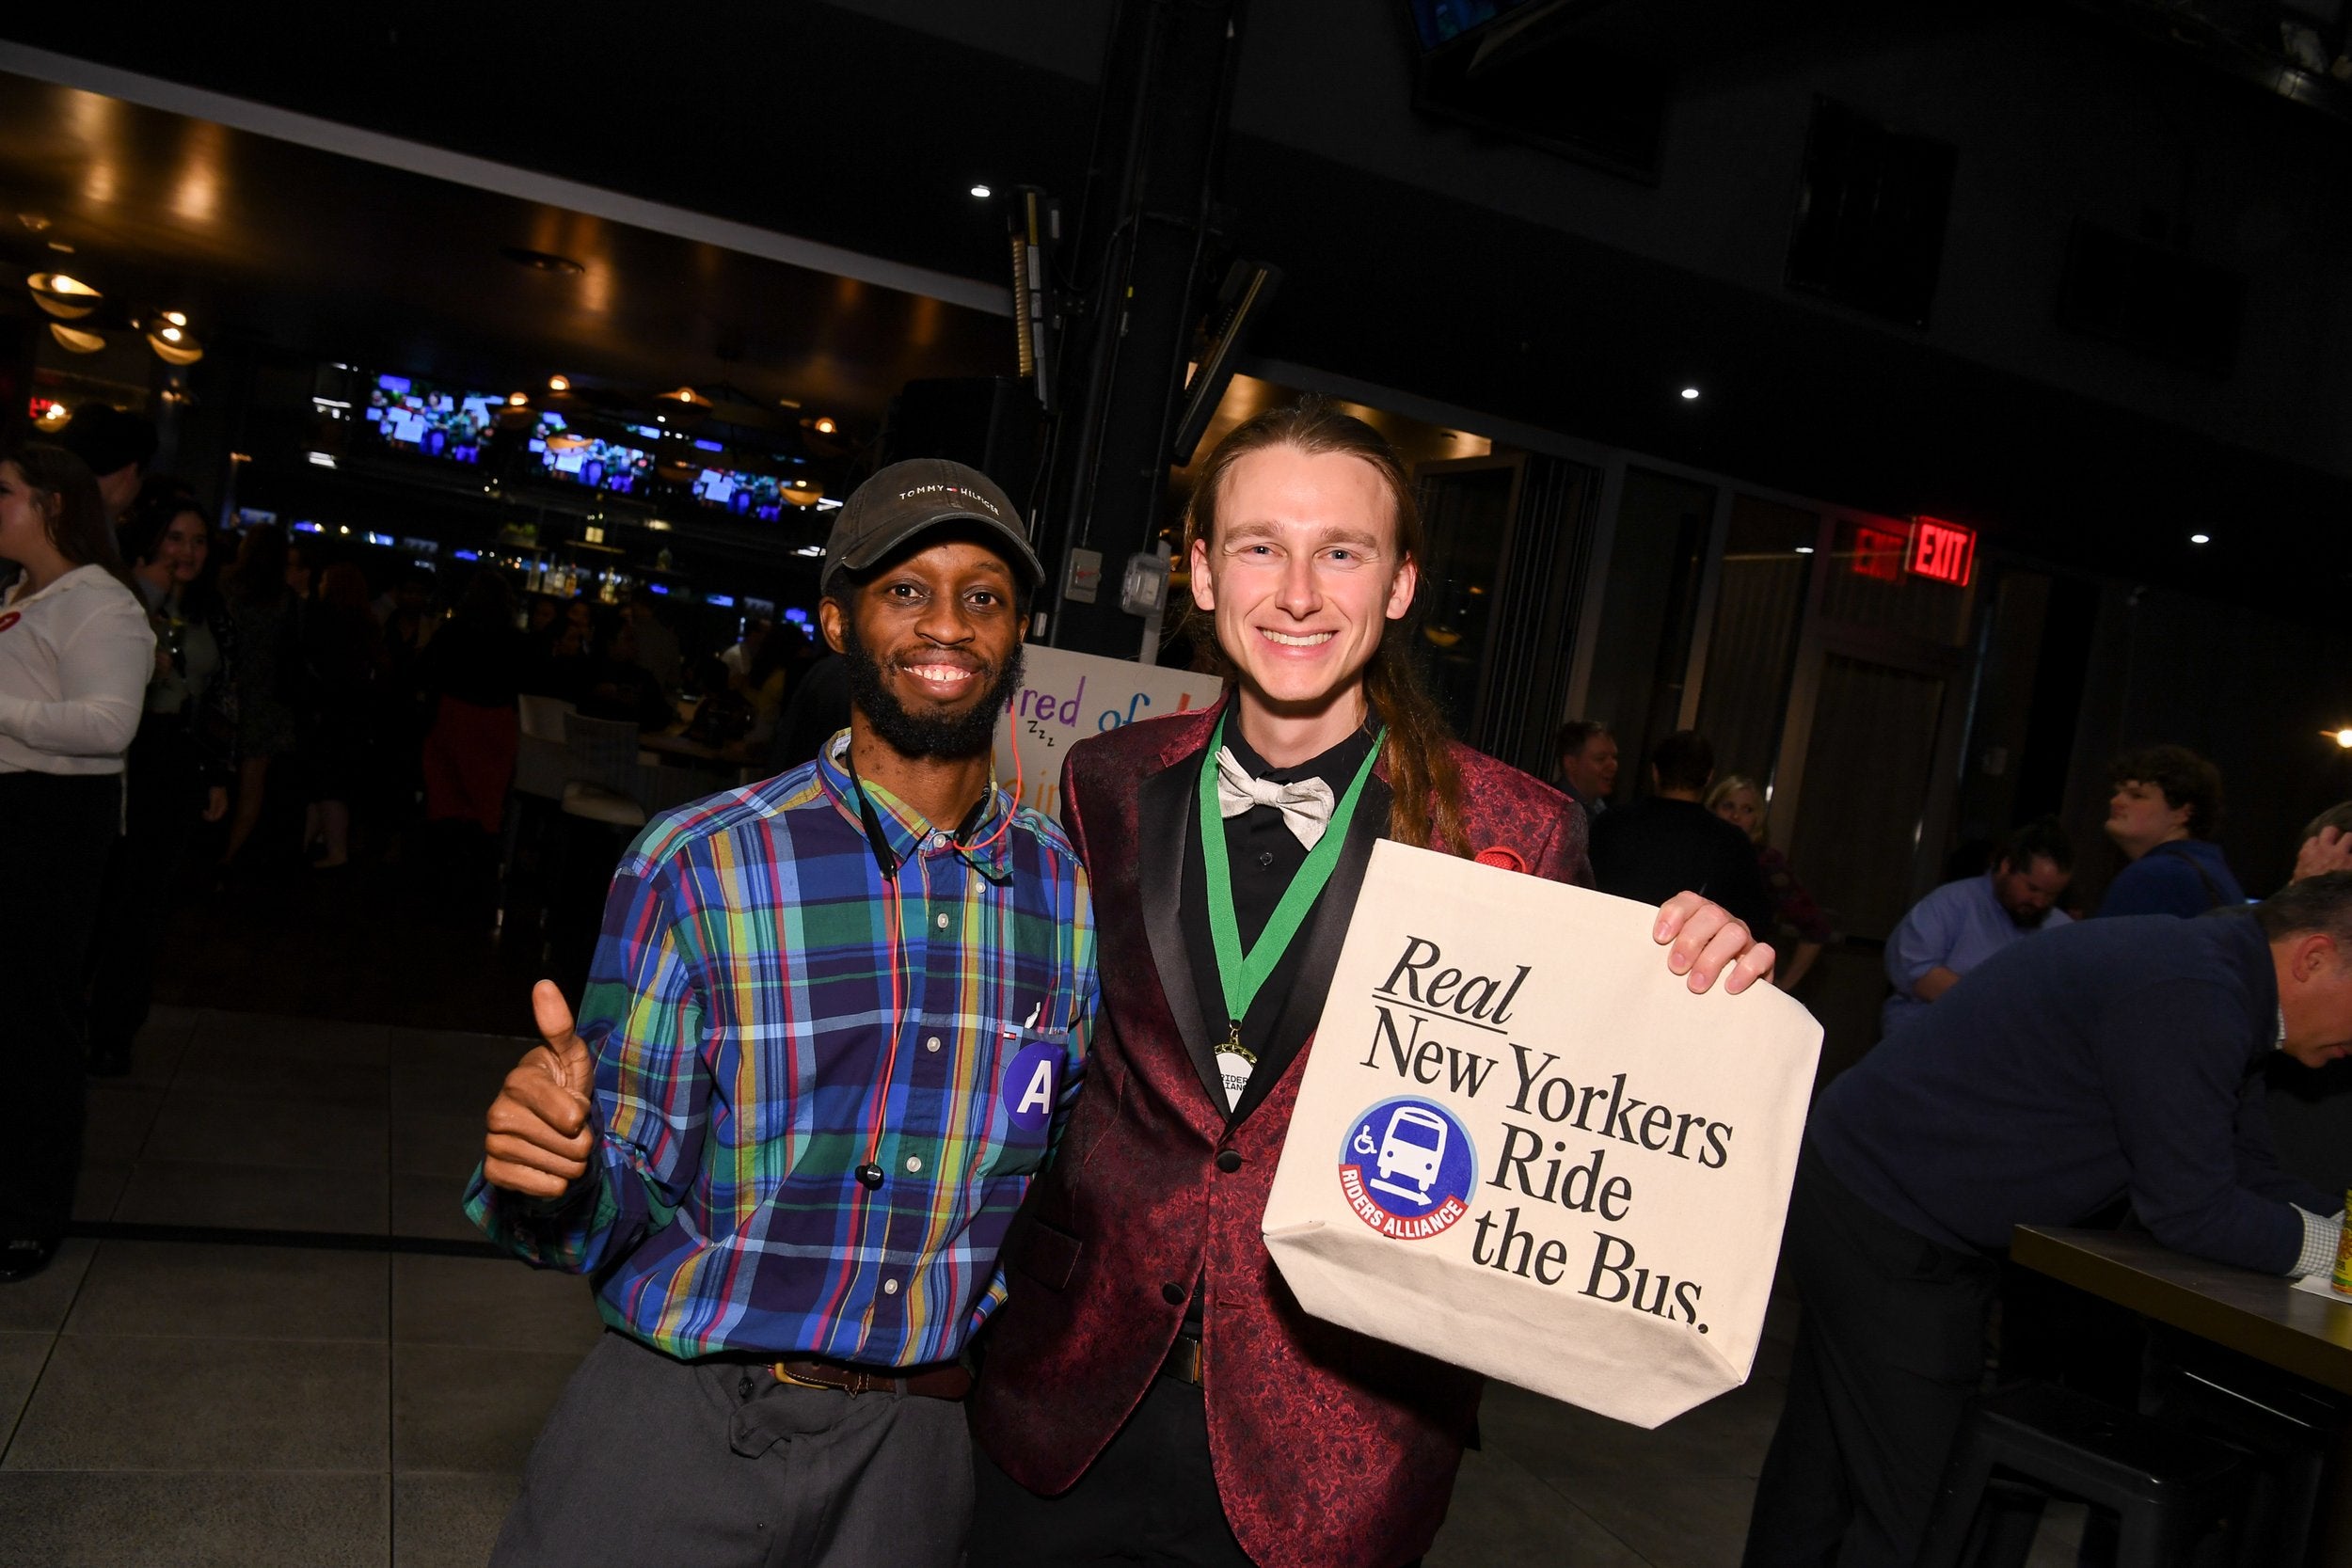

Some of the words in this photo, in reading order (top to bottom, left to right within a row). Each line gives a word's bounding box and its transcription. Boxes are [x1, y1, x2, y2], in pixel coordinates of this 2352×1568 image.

[899, 484, 944, 500] TOMMY
[1915, 523, 1968, 580] EXIT
[1374, 935, 1532, 1025] Real
[1016, 1059, 1052, 1115] A
[1359, 1006, 1499, 1098] New
[1505, 1043, 1733, 1169] Yorkers
[1342, 1169, 1385, 1227] RIDERS
[1383, 1199, 1463, 1238] ALLIANCE
[1486, 1122, 1632, 1222] Ride
[1471, 1207, 1567, 1286] the
[1578, 1230, 1708, 1334] Bus.
